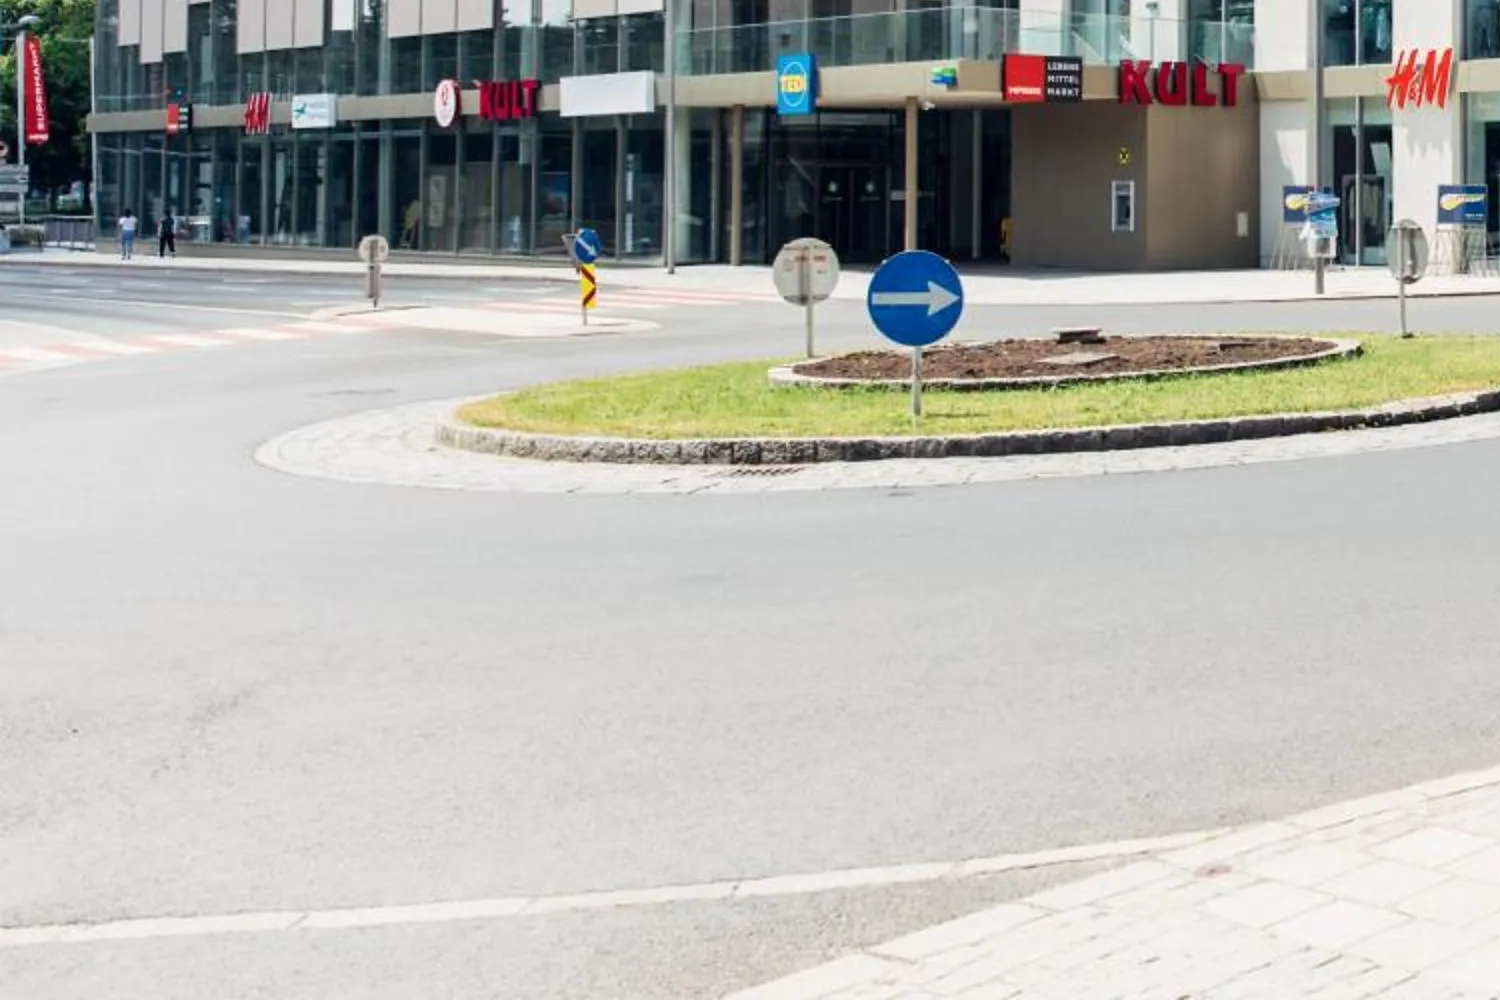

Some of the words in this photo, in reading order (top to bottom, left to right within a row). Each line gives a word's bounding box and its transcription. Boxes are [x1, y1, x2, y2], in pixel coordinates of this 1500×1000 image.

[480, 79, 542, 120] KULT
[1119, 59, 1245, 107] KULT
[1385, 48, 1453, 110] H&M
